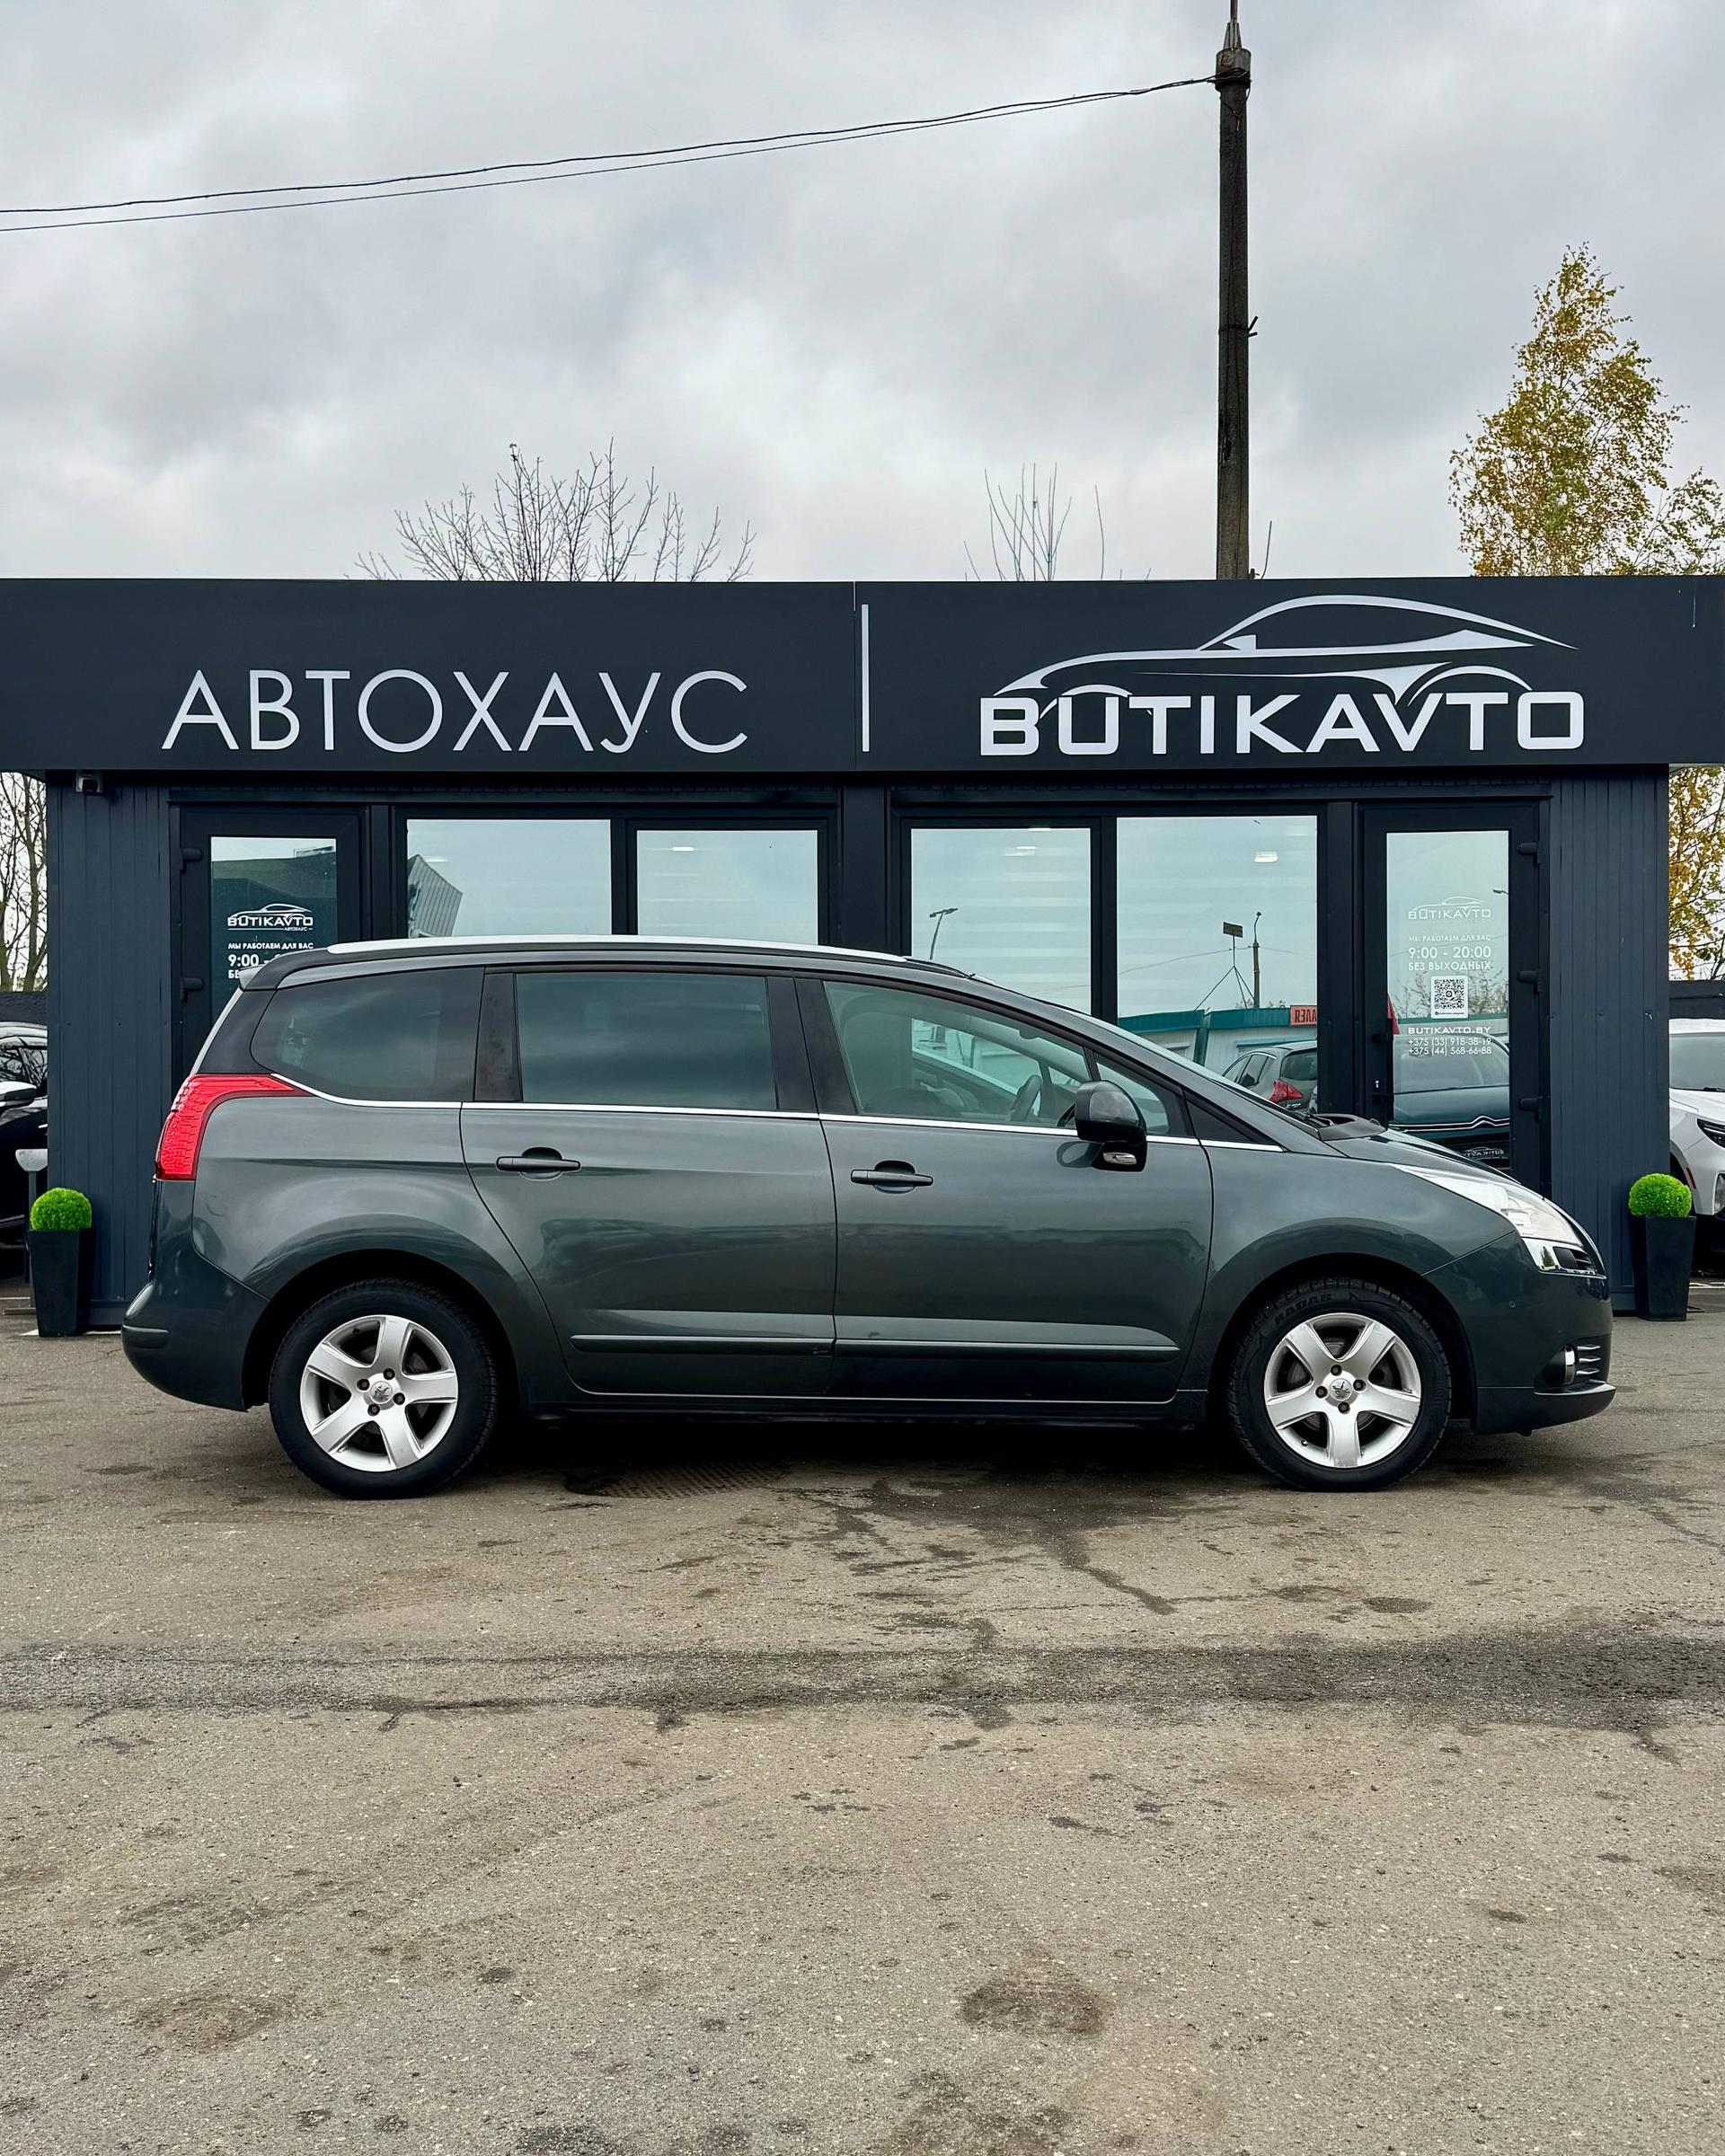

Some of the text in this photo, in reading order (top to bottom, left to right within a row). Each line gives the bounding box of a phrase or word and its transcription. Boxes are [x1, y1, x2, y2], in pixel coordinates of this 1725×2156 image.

[163, 669, 749, 755] АВТОХАУС
[980, 690, 1585, 756] BUTIKAVTO
[1408, 908, 1491, 919] BUTIKAVTO
[227, 915, 314, 927] BUTIKAVTO
[1422, 934, 1459, 942] РАБОТАЕМ
[1461, 934, 1475, 942] ДЛЯ
[281, 942, 297, 950] ДЛЯ
[1408, 947, 1438, 959] 9:00
[1453, 946, 1491, 959] 20:00
[227, 954, 260, 968] 9:00
[1408, 960, 1491, 971] БЕЗ ВЫХОДНЫХ
[228, 969, 240, 979] БЕ
[1408, 1026, 1491, 1035] BUTIKAVTO.BY
[1408, 1037, 1491, 1047] +375 (33) 918-38-19
[1408, 1046, 1492, 1056] +375 (44) 568-66-88
